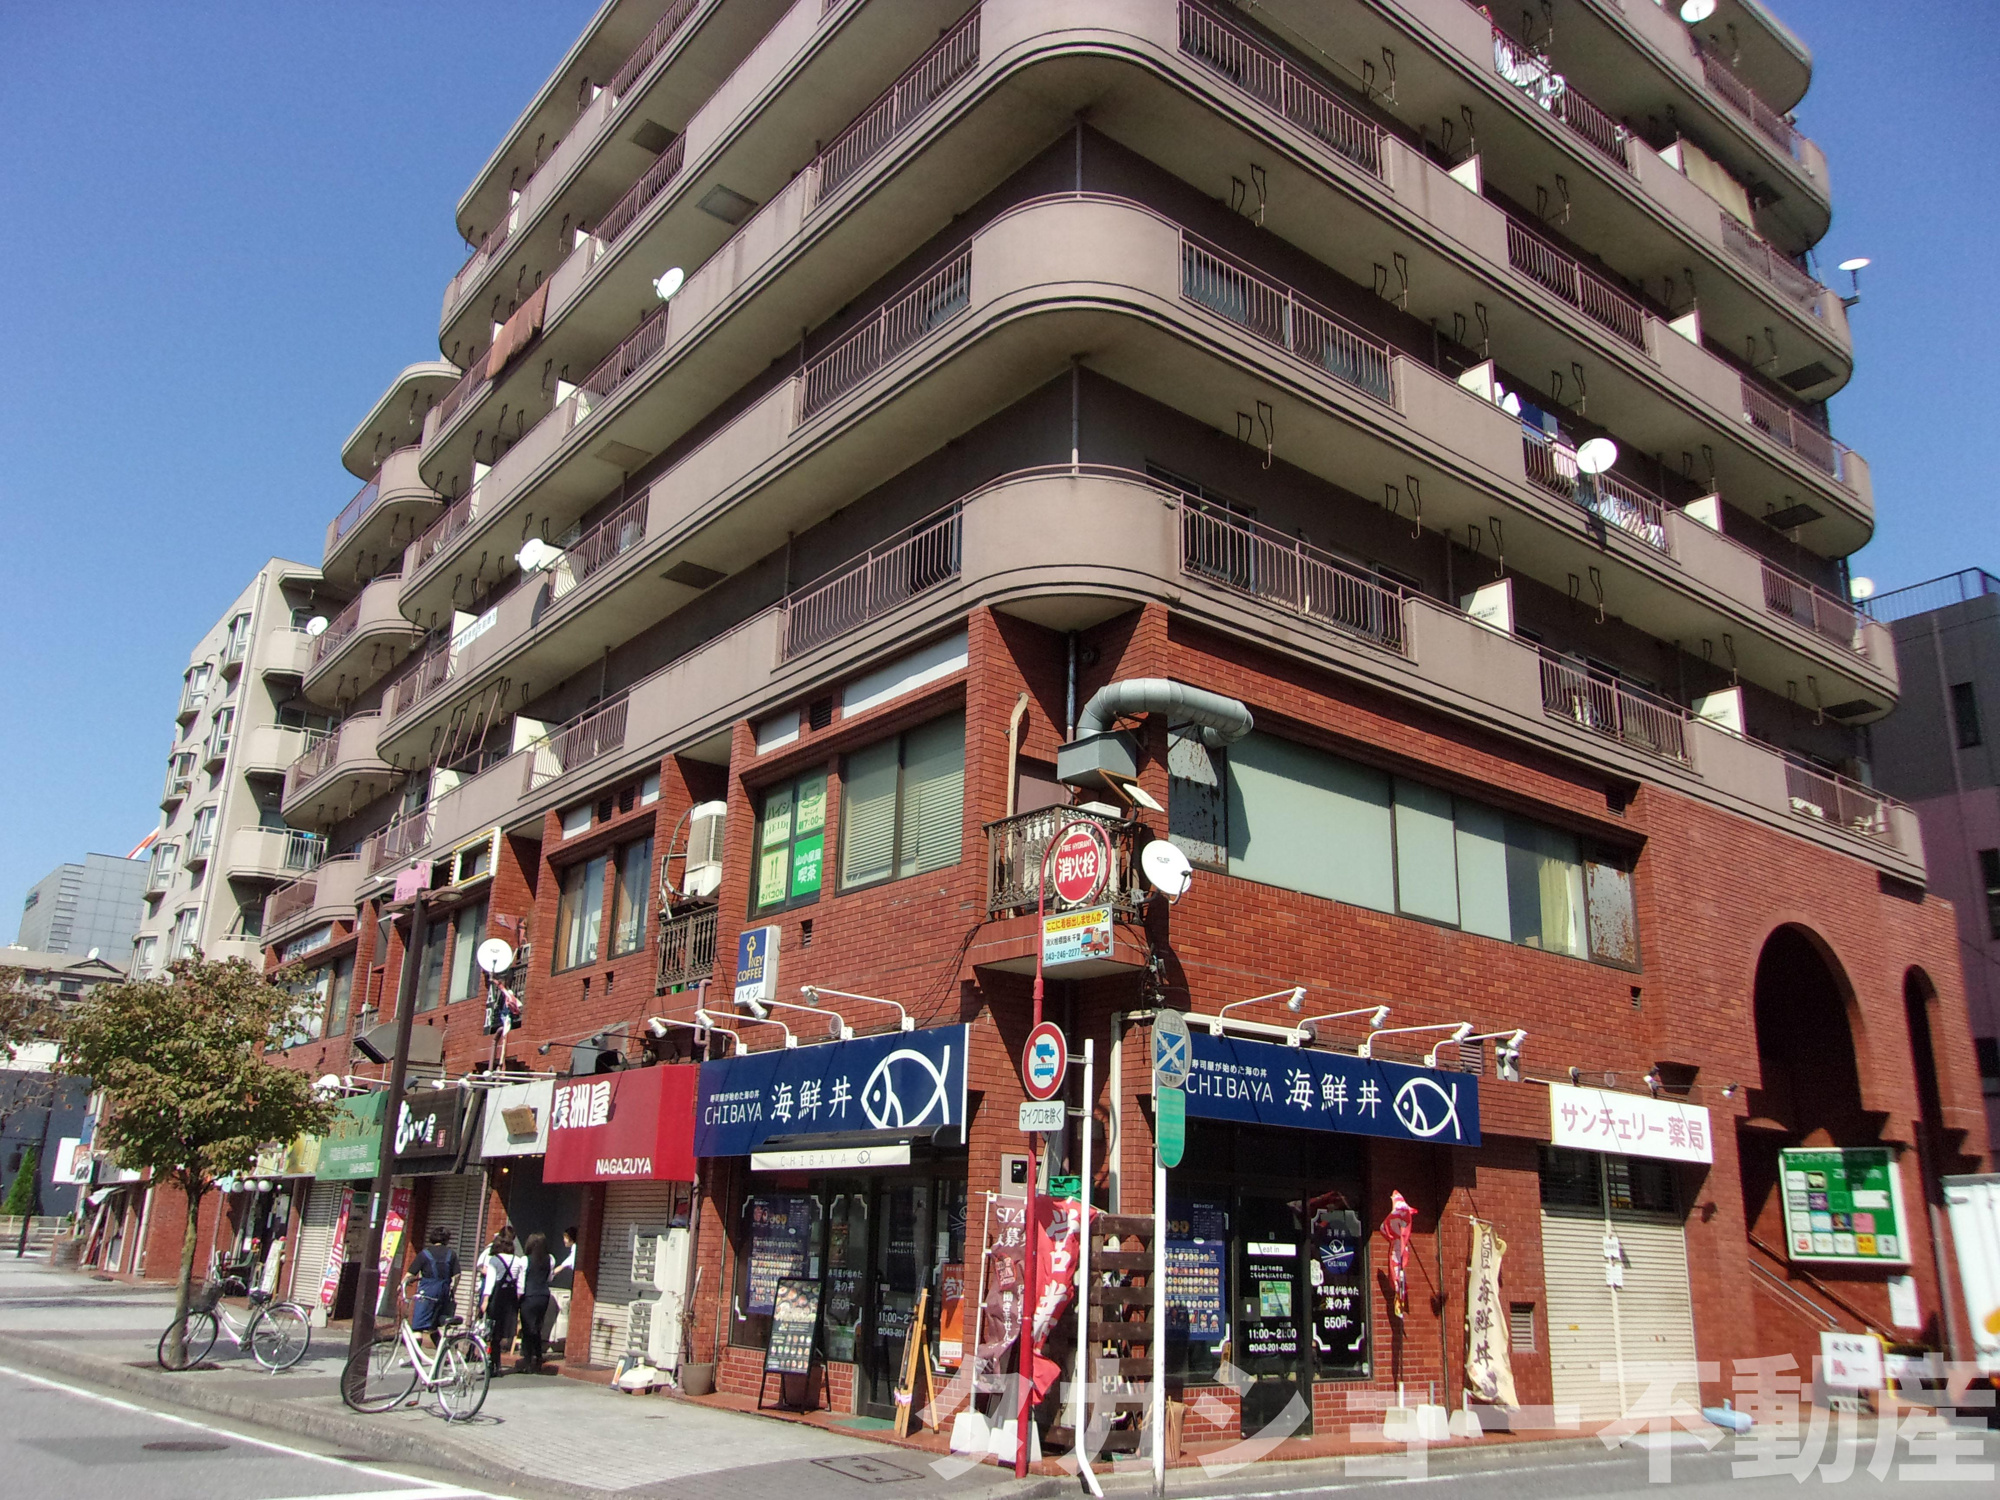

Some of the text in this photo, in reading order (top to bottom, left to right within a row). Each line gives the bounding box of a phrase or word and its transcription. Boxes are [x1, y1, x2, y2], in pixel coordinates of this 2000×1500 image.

[767, 802, 790, 820] ハイジ
[1061, 839, 1092, 853] FIRE HYDRANT
[797, 863, 817, 883] 喫茶
[1058, 850, 1097, 884] 消火栓
[1045, 947, 1081, 961] 043-246-2277
[737, 967, 763, 982] COFFEE
[737, 986, 759, 1001] ハイジ
[1191, 1058, 1268, 1078] 寿司屋が始めた海の丼
[1185, 1072, 1274, 1104] CHIBAYA
[1284, 1068, 1382, 1119] 海鮮丼
[552, 1080, 611, 1130] 長洲屋
[770, 1075, 853, 1124] 海鮮丼
[704, 1101, 763, 1126] CHIBAYA
[1020, 1106, 1063, 1126] マイクロを除く
[1560, 1102, 1705, 1151] サンチェリー薬局
[595, 1157, 652, 1175] NAGAZUYA
[780, 1153, 847, 1167] CHIBAYA
[996, 1207, 1026, 1224] STA
[1317, 1285, 1360, 1295] 寿司屋が始めた
[1325, 1297, 1351, 1311] 海の丼
